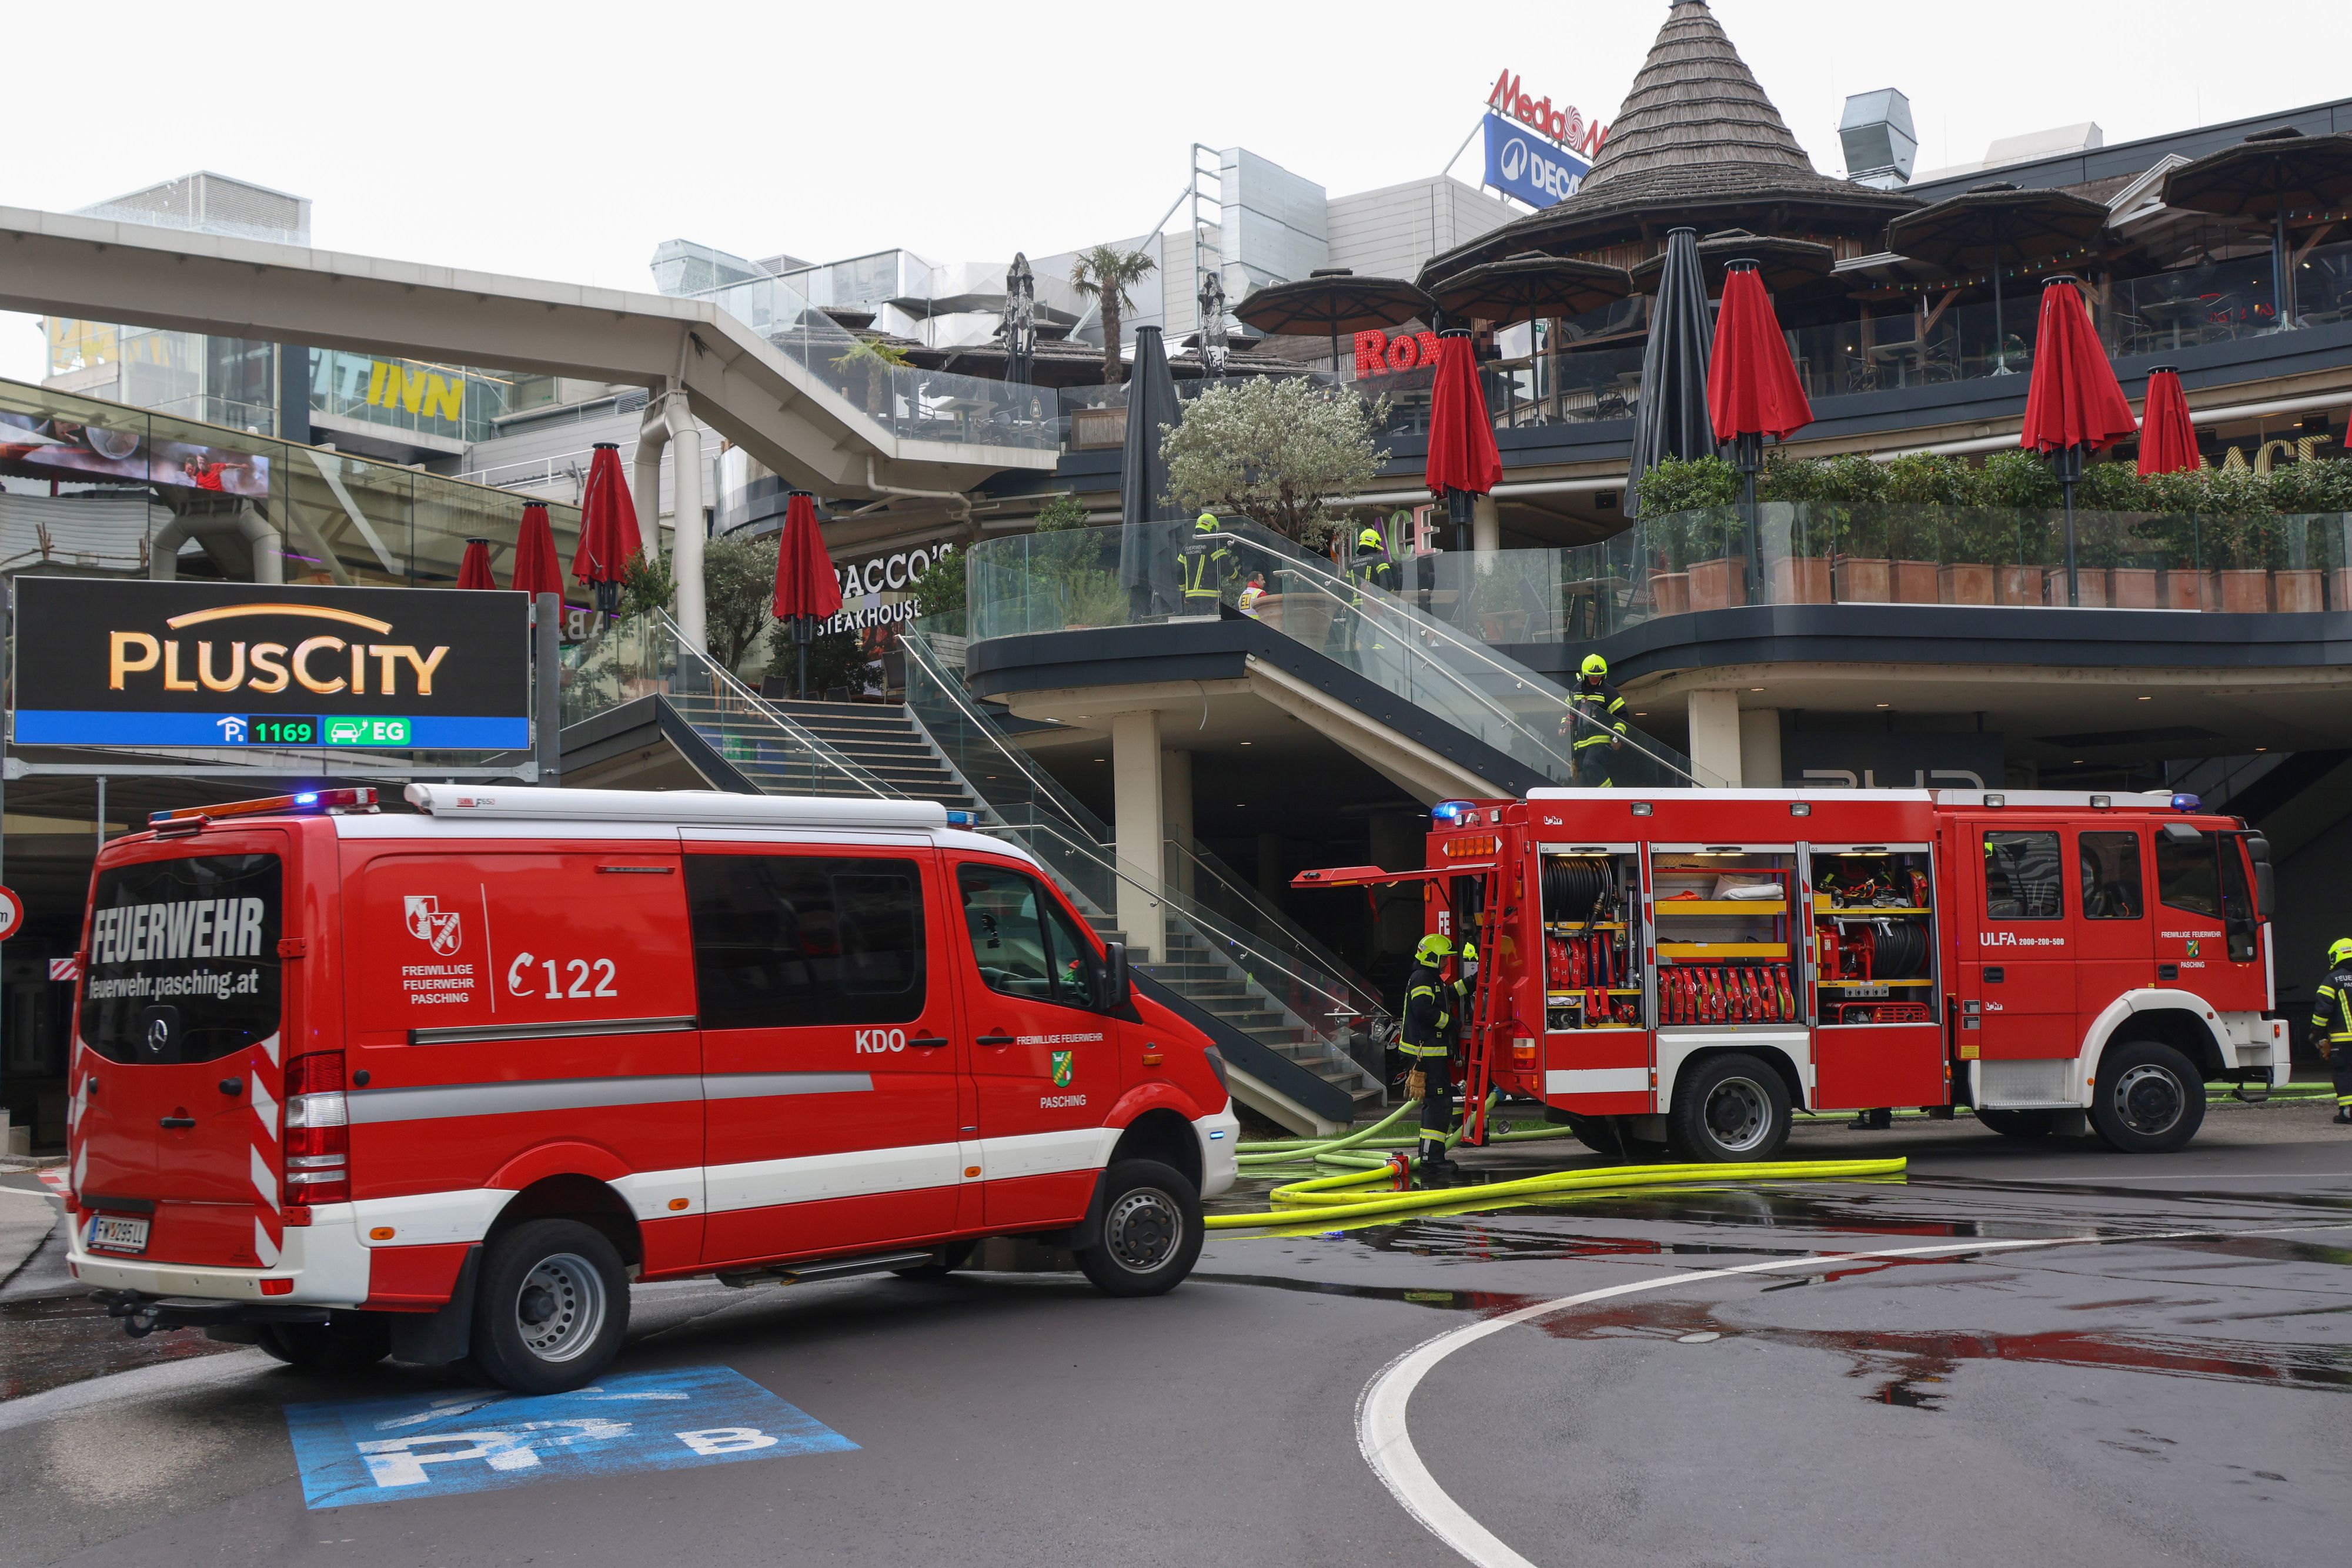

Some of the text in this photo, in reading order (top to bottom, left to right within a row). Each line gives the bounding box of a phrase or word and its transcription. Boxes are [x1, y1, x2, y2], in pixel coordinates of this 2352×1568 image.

[1488, 68, 1564, 141] Media
[1531, 152, 1582, 200] DECA
[834, 543, 953, 599] ACCO'
[1241, 597, 1250, 607] EL
[255, 723, 311, 741] 1169
[373, 722, 404, 740] EG
[1544, 815, 1562, 825] Lohr
[91, 898, 264, 965] FEUERWEHR
[1980, 932, 2017, 946] ULFA
[402, 964, 473, 977] FREIWILLIGE
[542, 958, 618, 999] 122
[89, 969, 259, 1001] feuerwehr.pasching.at
[403, 978, 475, 990] FEUERWEHR
[411, 992, 469, 1005] PASCHING
[855, 1028, 906, 1054] KDO
[1016, 1032, 1104, 1045] FREIWILLIGE FEUERWEHR
[1040, 1094, 1087, 1109] PASCHING
